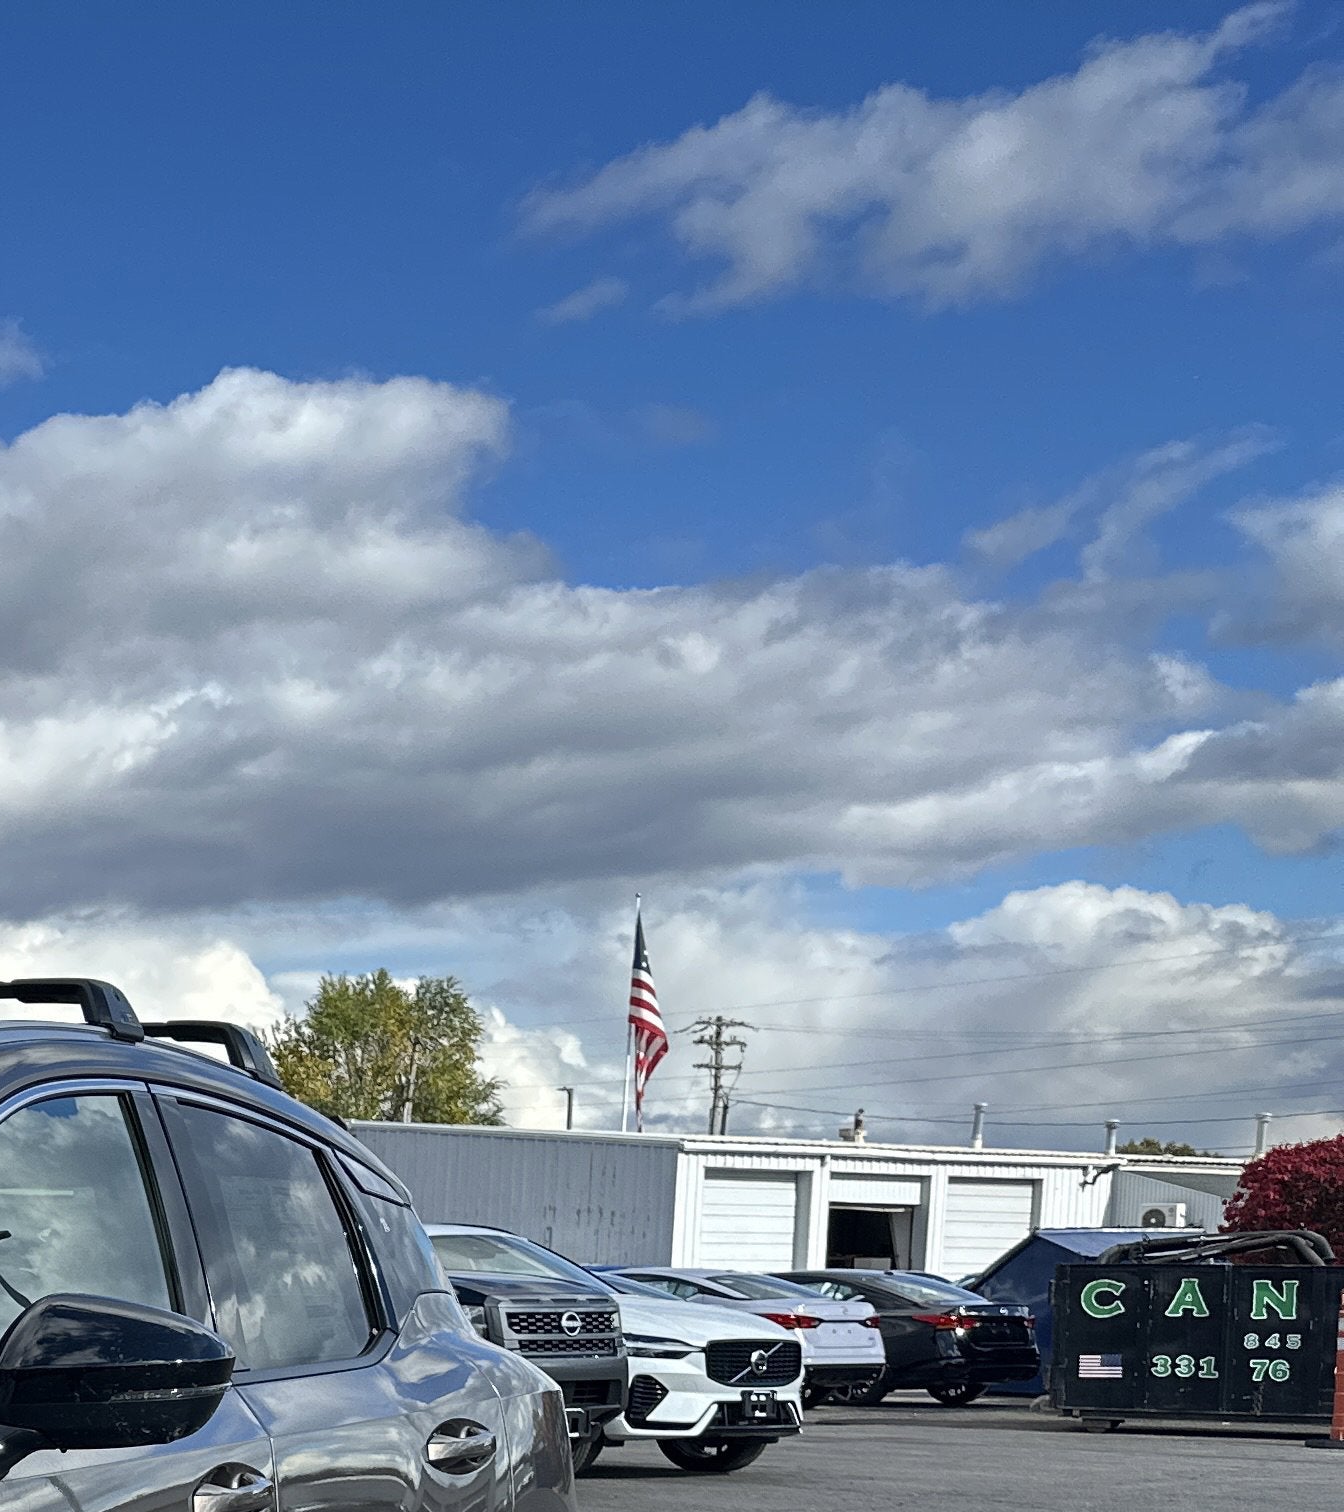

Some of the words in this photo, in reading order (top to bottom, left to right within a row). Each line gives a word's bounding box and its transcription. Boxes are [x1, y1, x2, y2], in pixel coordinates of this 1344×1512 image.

[1243, 1333, 1302, 1349] 845
[1151, 1355, 1219, 1378] 331
[1250, 1359, 1290, 1381] 76
